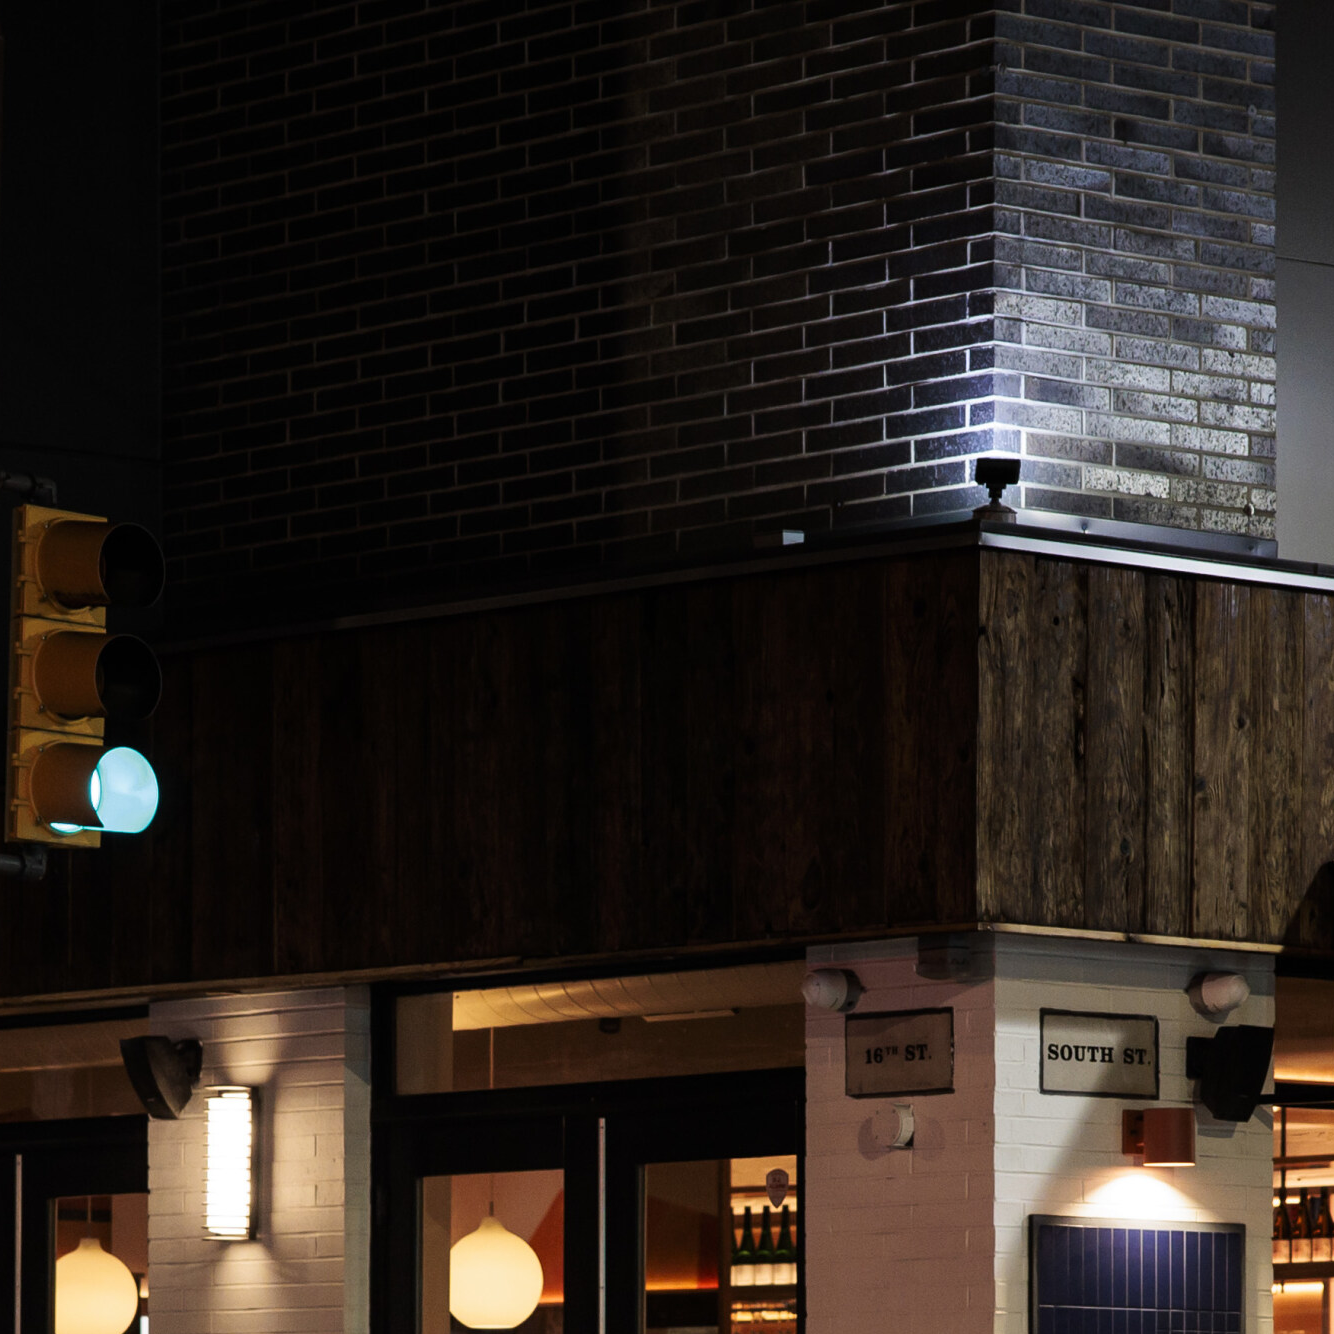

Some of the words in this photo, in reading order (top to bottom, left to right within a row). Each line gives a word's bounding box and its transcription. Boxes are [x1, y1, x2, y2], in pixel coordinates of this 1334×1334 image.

[865, 1046, 899, 1065] 16TH
[905, 1044, 932, 1061] ST.
[1047, 1043, 1114, 1063] SOUTH
[1123, 1047, 1152, 1065] ST.
